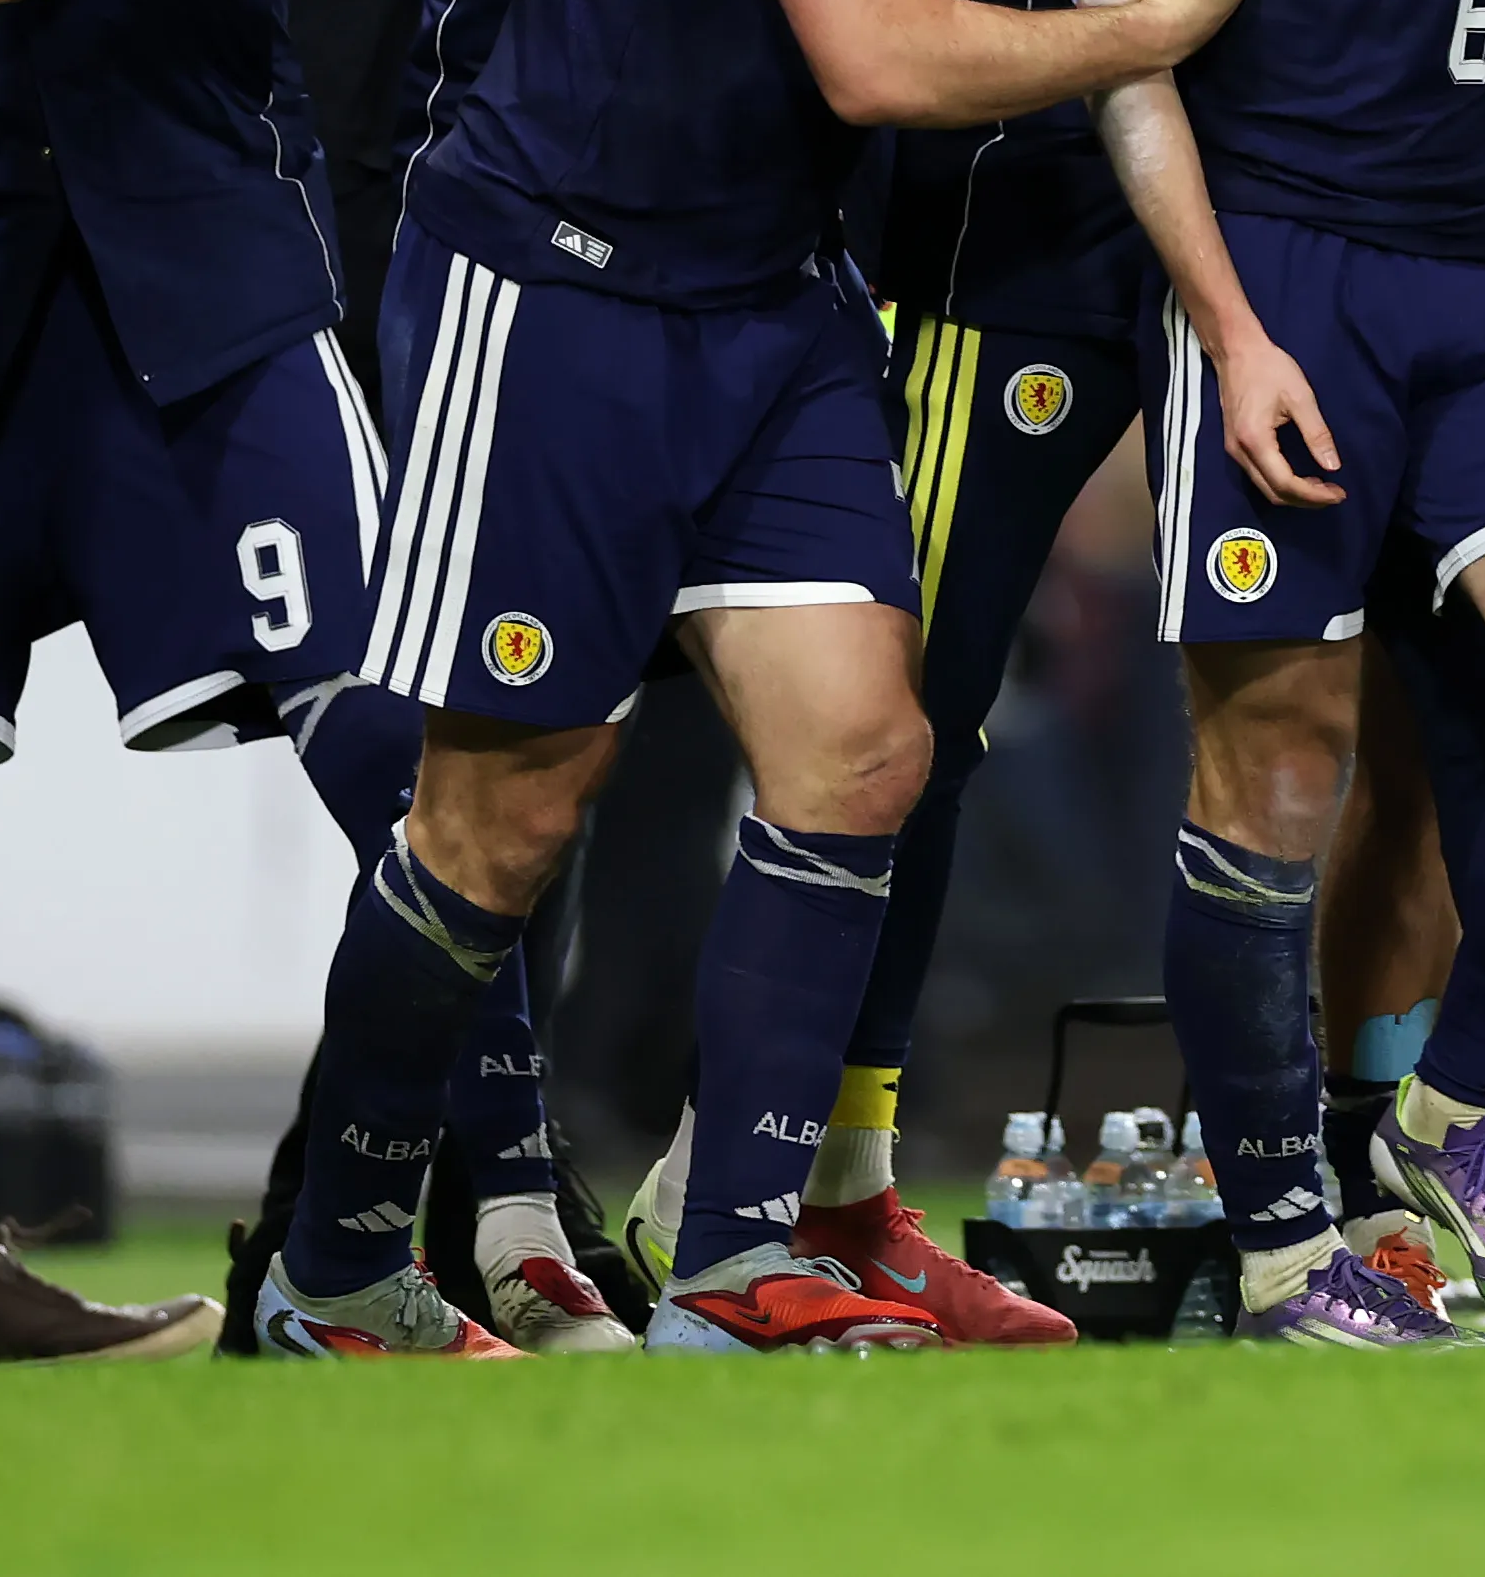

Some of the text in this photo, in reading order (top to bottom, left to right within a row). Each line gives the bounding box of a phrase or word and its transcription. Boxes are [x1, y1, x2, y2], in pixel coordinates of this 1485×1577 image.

[236, 517, 313, 652] 9
[480, 1053, 543, 1078] ALB
[341, 1123, 430, 1160] ALBA
[1237, 1133, 1322, 1159] ALBA
[1056, 1243, 1158, 1294] Squash
